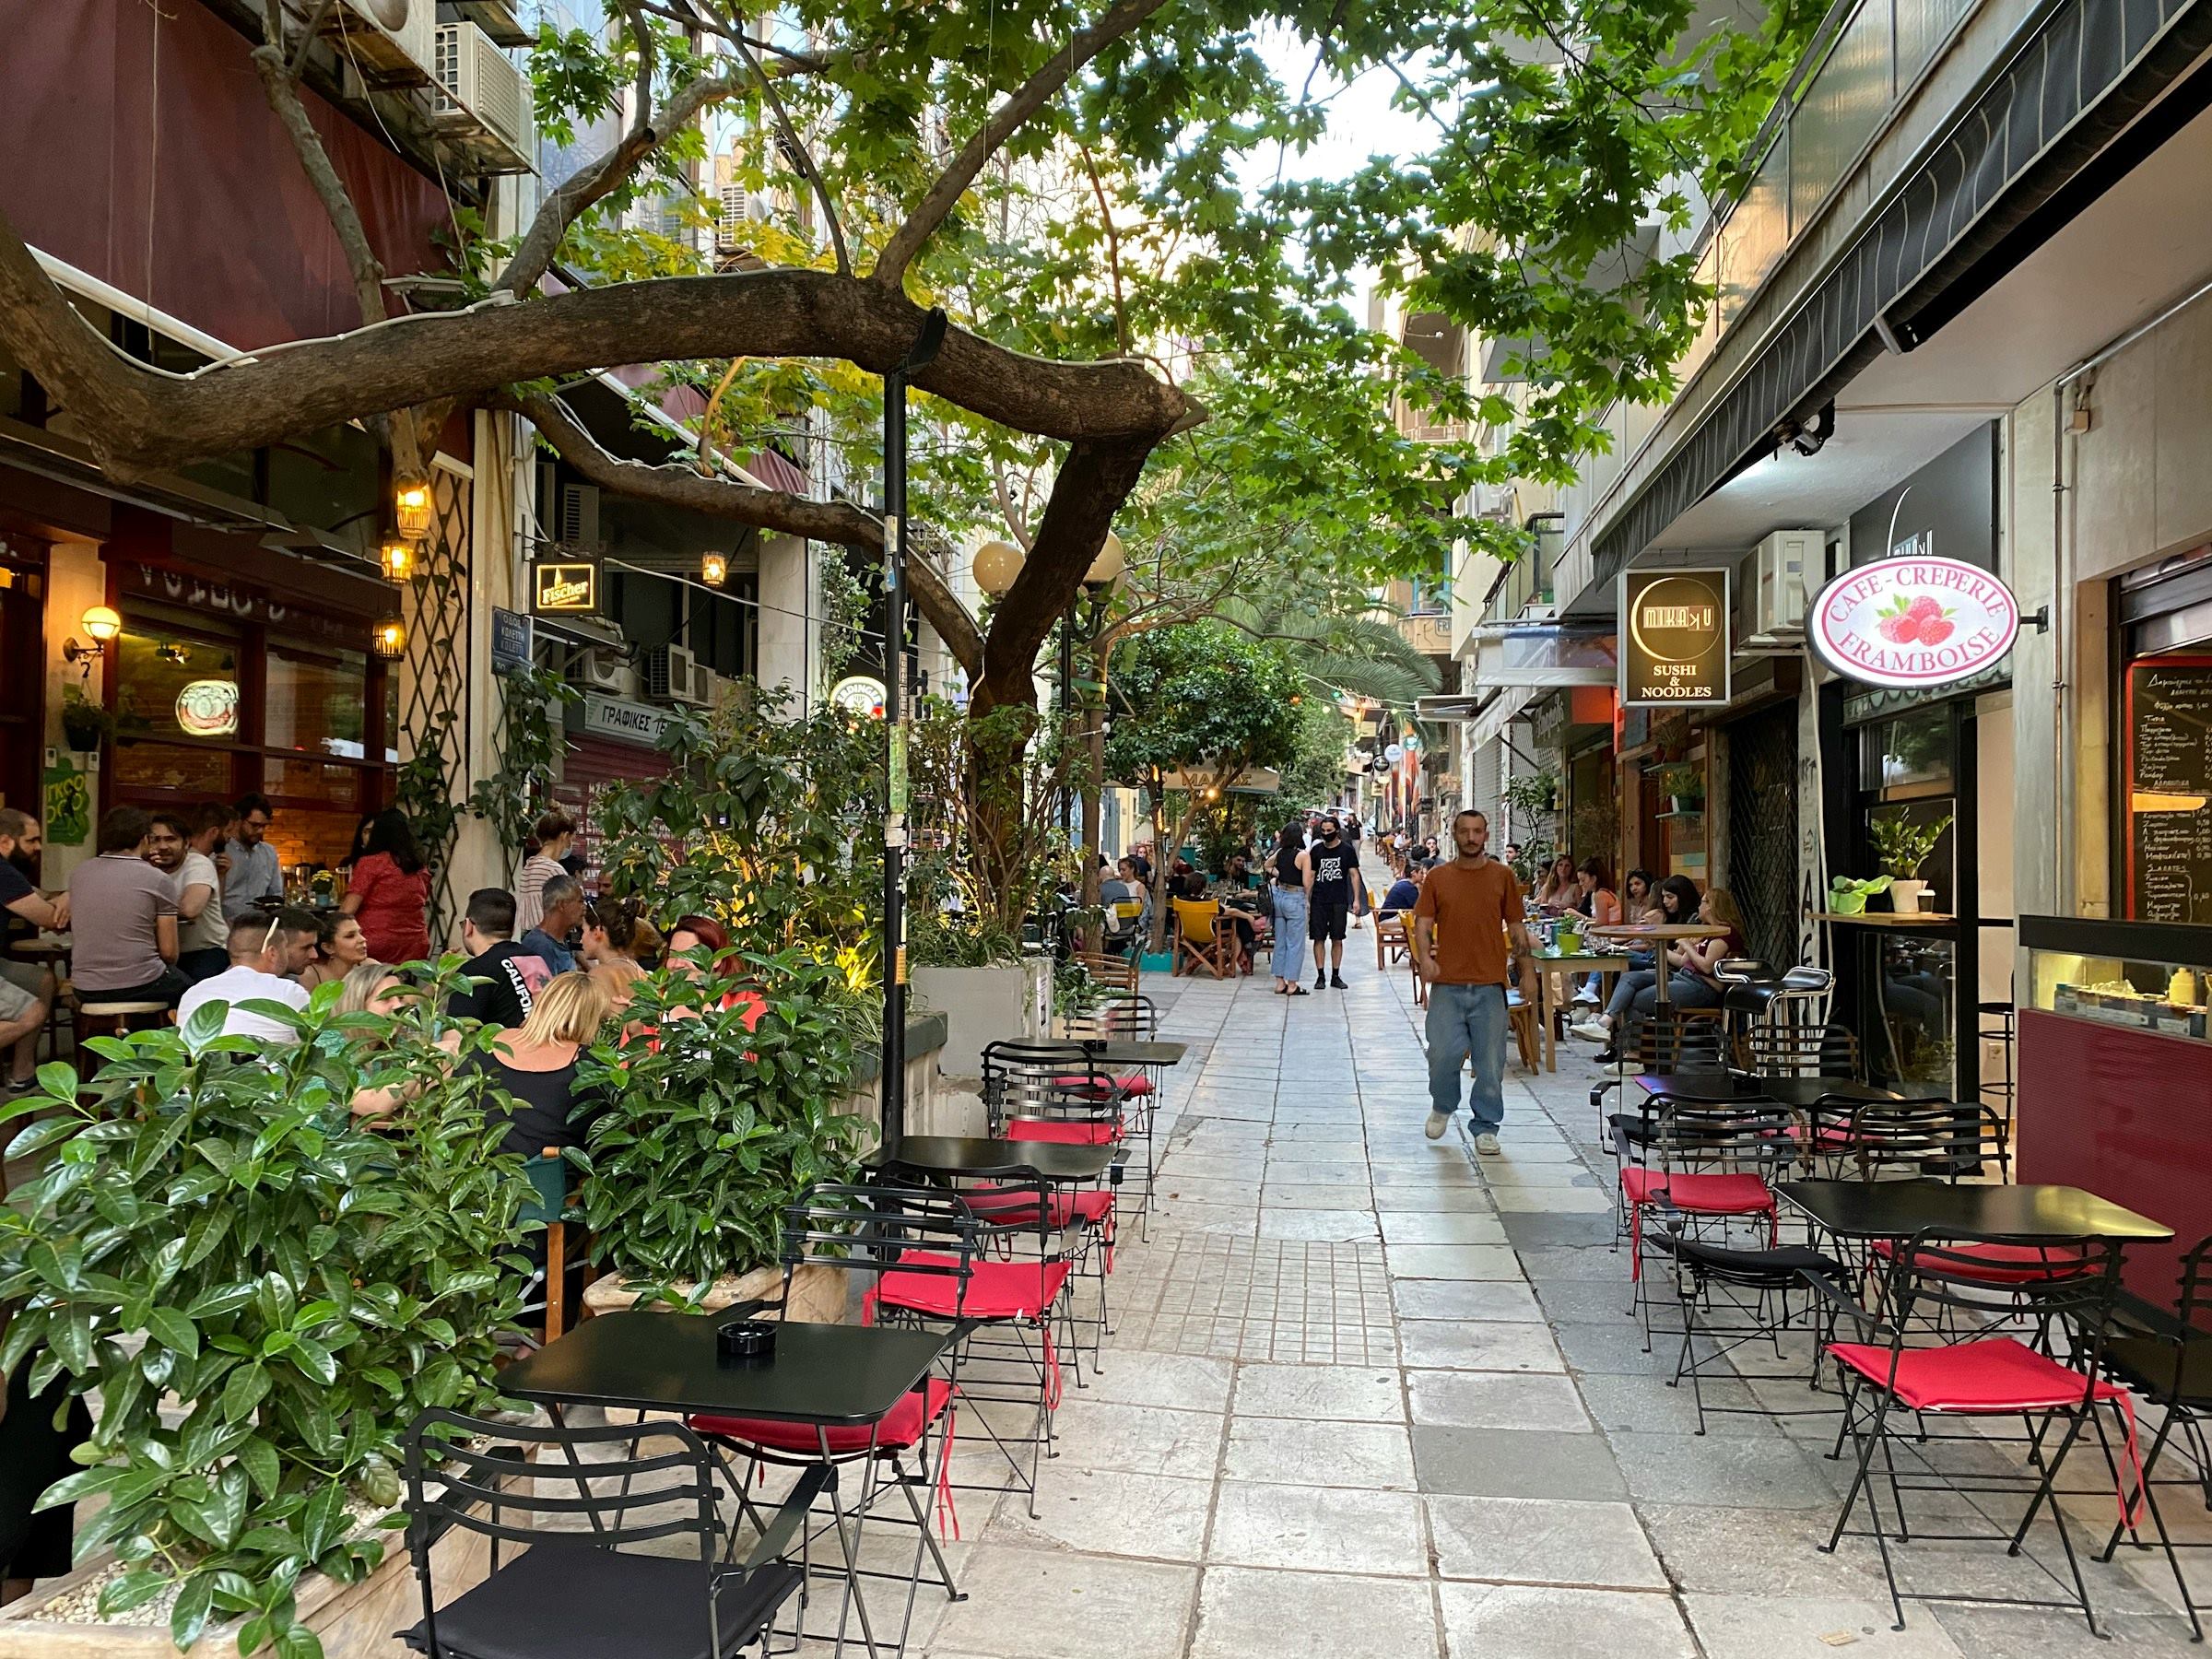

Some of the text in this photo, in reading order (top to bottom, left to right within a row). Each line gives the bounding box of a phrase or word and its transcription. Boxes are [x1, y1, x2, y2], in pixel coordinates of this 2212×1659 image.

[542, 582, 588, 605] Fischer
[1830, 575, 1883, 622] CAFE
[1896, 567, 2006, 618] CREPERIE
[1645, 607, 1712, 630] MIKAKU
[1838, 626, 2000, 672] FRAMBOISE
[1653, 665, 1696, 676] SUSHI
[1669, 677, 1680, 687] &
[1641, 687, 1712, 698] NOODLES
[602, 705, 652, 732] ΓΡΑΦΙΚΕΣ
